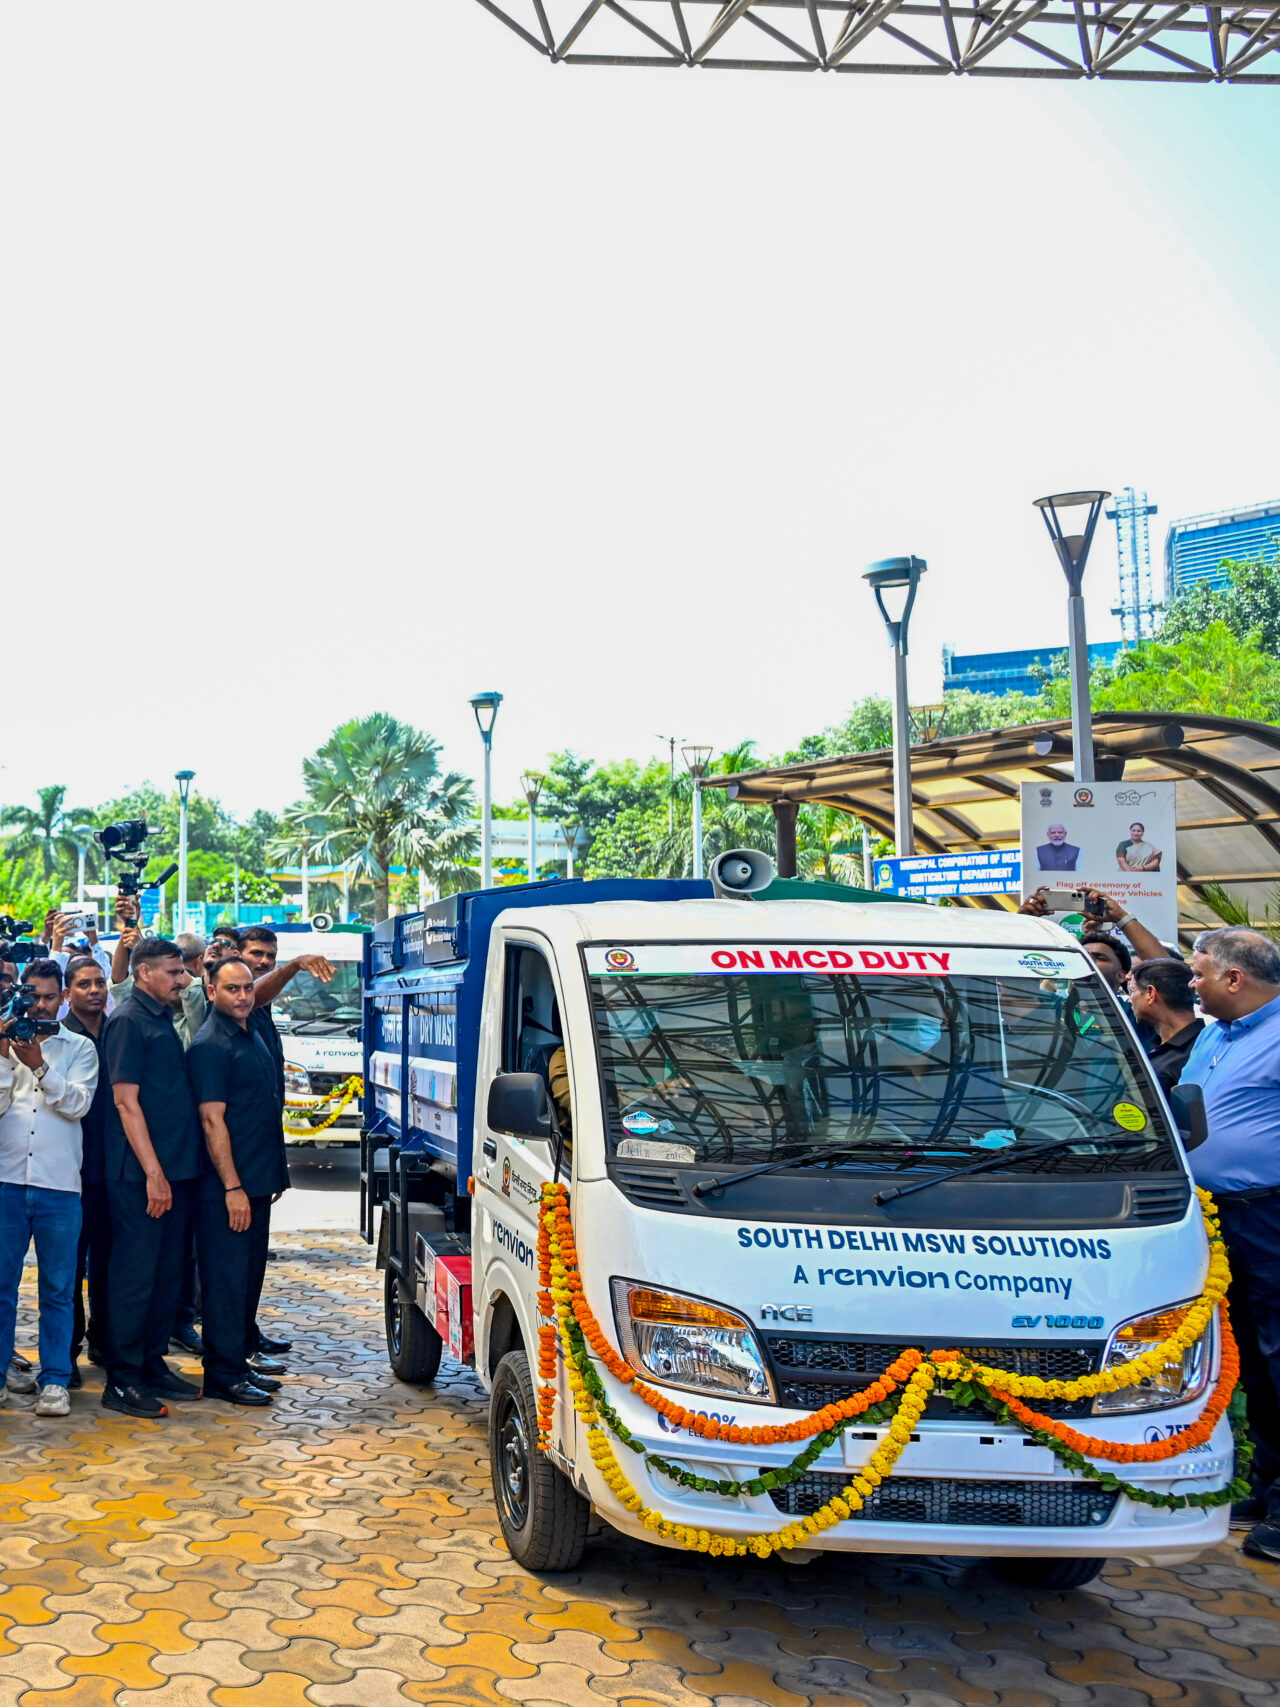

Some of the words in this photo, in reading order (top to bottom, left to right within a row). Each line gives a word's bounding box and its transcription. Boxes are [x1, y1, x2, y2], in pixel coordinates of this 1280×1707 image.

[900, 858, 937, 870] MUNICIPAL
[938, 855, 988, 868] CORPORATION
[990, 853, 1000, 864] OF
[910, 871, 960, 883] HORTICULTURE
[962, 867, 1012, 880] DEPARTMENT
[1056, 881, 1073, 889] Flag
[926, 884, 957, 895] NURSERY
[711, 950, 765, 969] ON
[769, 950, 853, 969] MCD
[858, 951, 950, 971] DUTY
[420, 1014, 433, 1045] DRY
[434, 1014, 456, 1047] WAST
[492, 1219, 534, 1271] renvion
[737, 1227, 820, 1249] SOUTH
[828, 1230, 898, 1252] DELHI
[901, 1232, 966, 1254] MSW
[972, 1235, 1112, 1260] SOLUTIONS
[793, 1265, 809, 1284] A
[818, 1265, 949, 1289] renvion
[955, 1270, 1073, 1300] Company
[759, 1303, 814, 1323] ACE
[1011, 1315, 1042, 1328] EV
[1044, 1315, 1105, 1330] 1000
